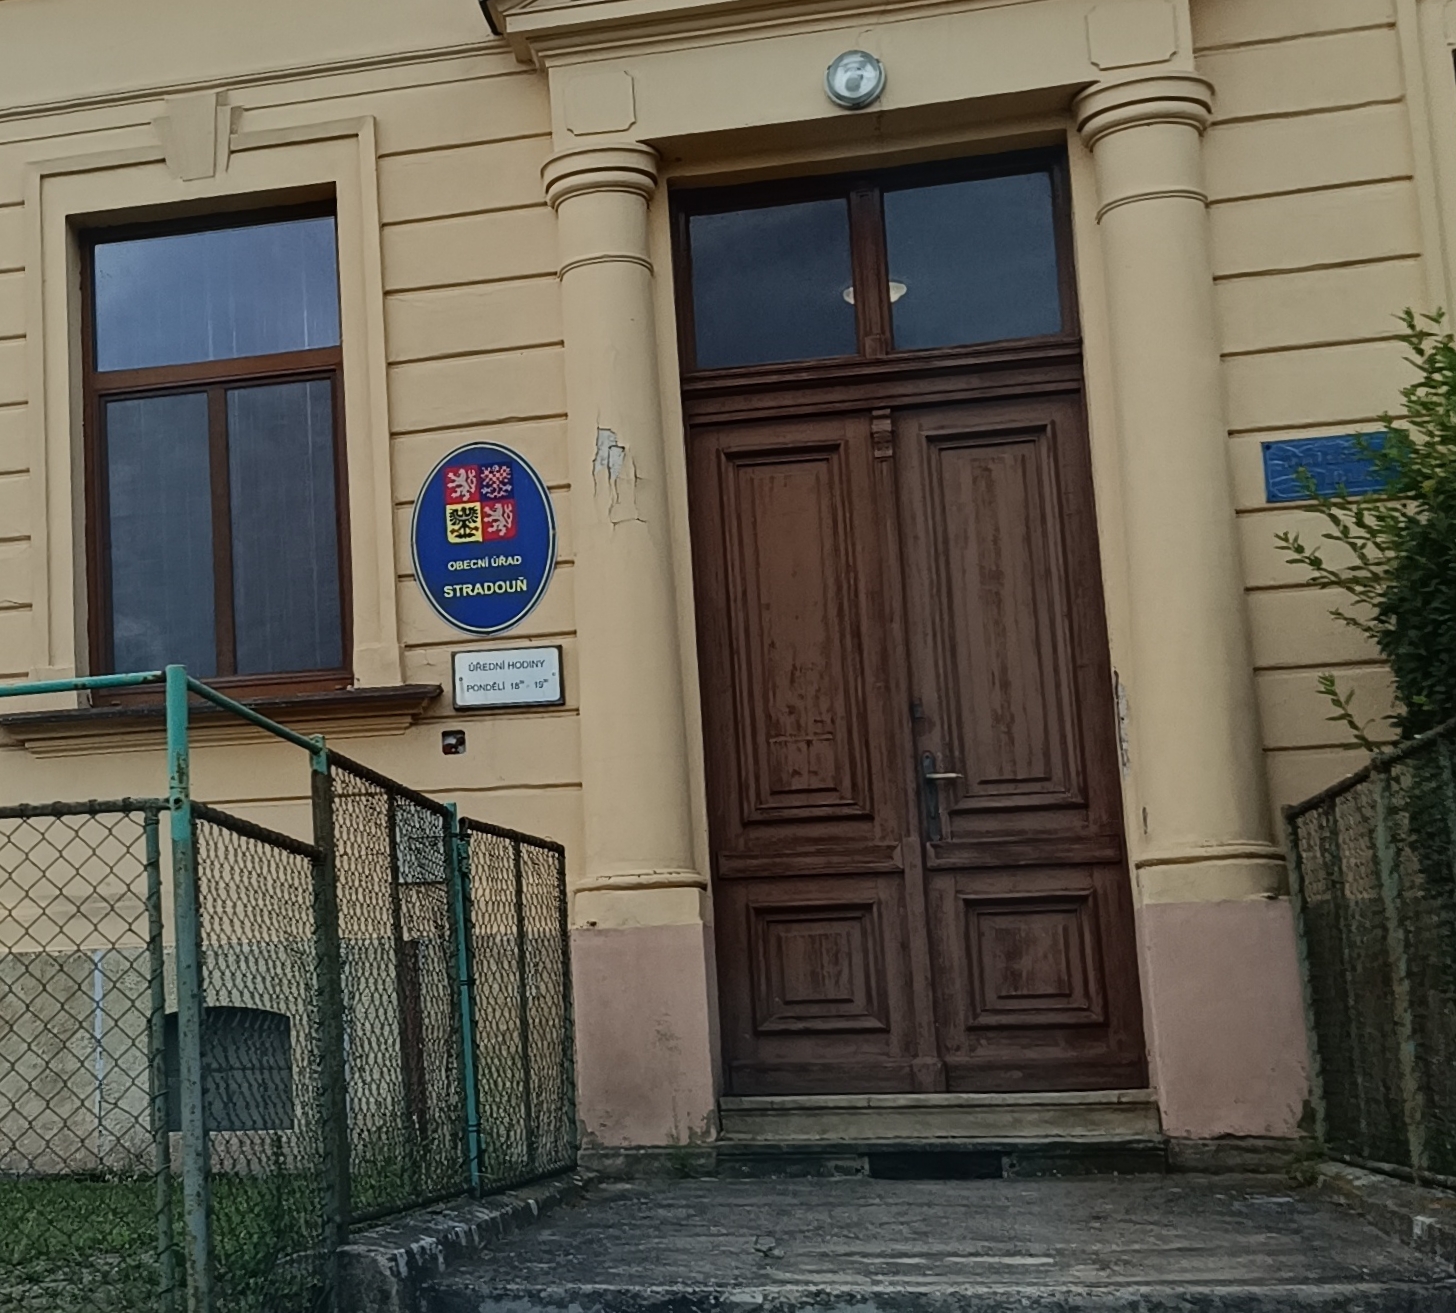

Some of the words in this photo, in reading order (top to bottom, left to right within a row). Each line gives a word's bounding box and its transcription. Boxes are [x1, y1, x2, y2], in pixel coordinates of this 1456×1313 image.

[448, 557, 488, 571] OBECNÍ
[491, 555, 522, 567] ÚŘAD
[444, 577, 527, 598] STRADOUŇ
[468, 660, 505, 672] ÚŘEDNÍ
[508, 659, 545, 670] HODINY
[467, 681, 505, 692] PONDĚLÍ
